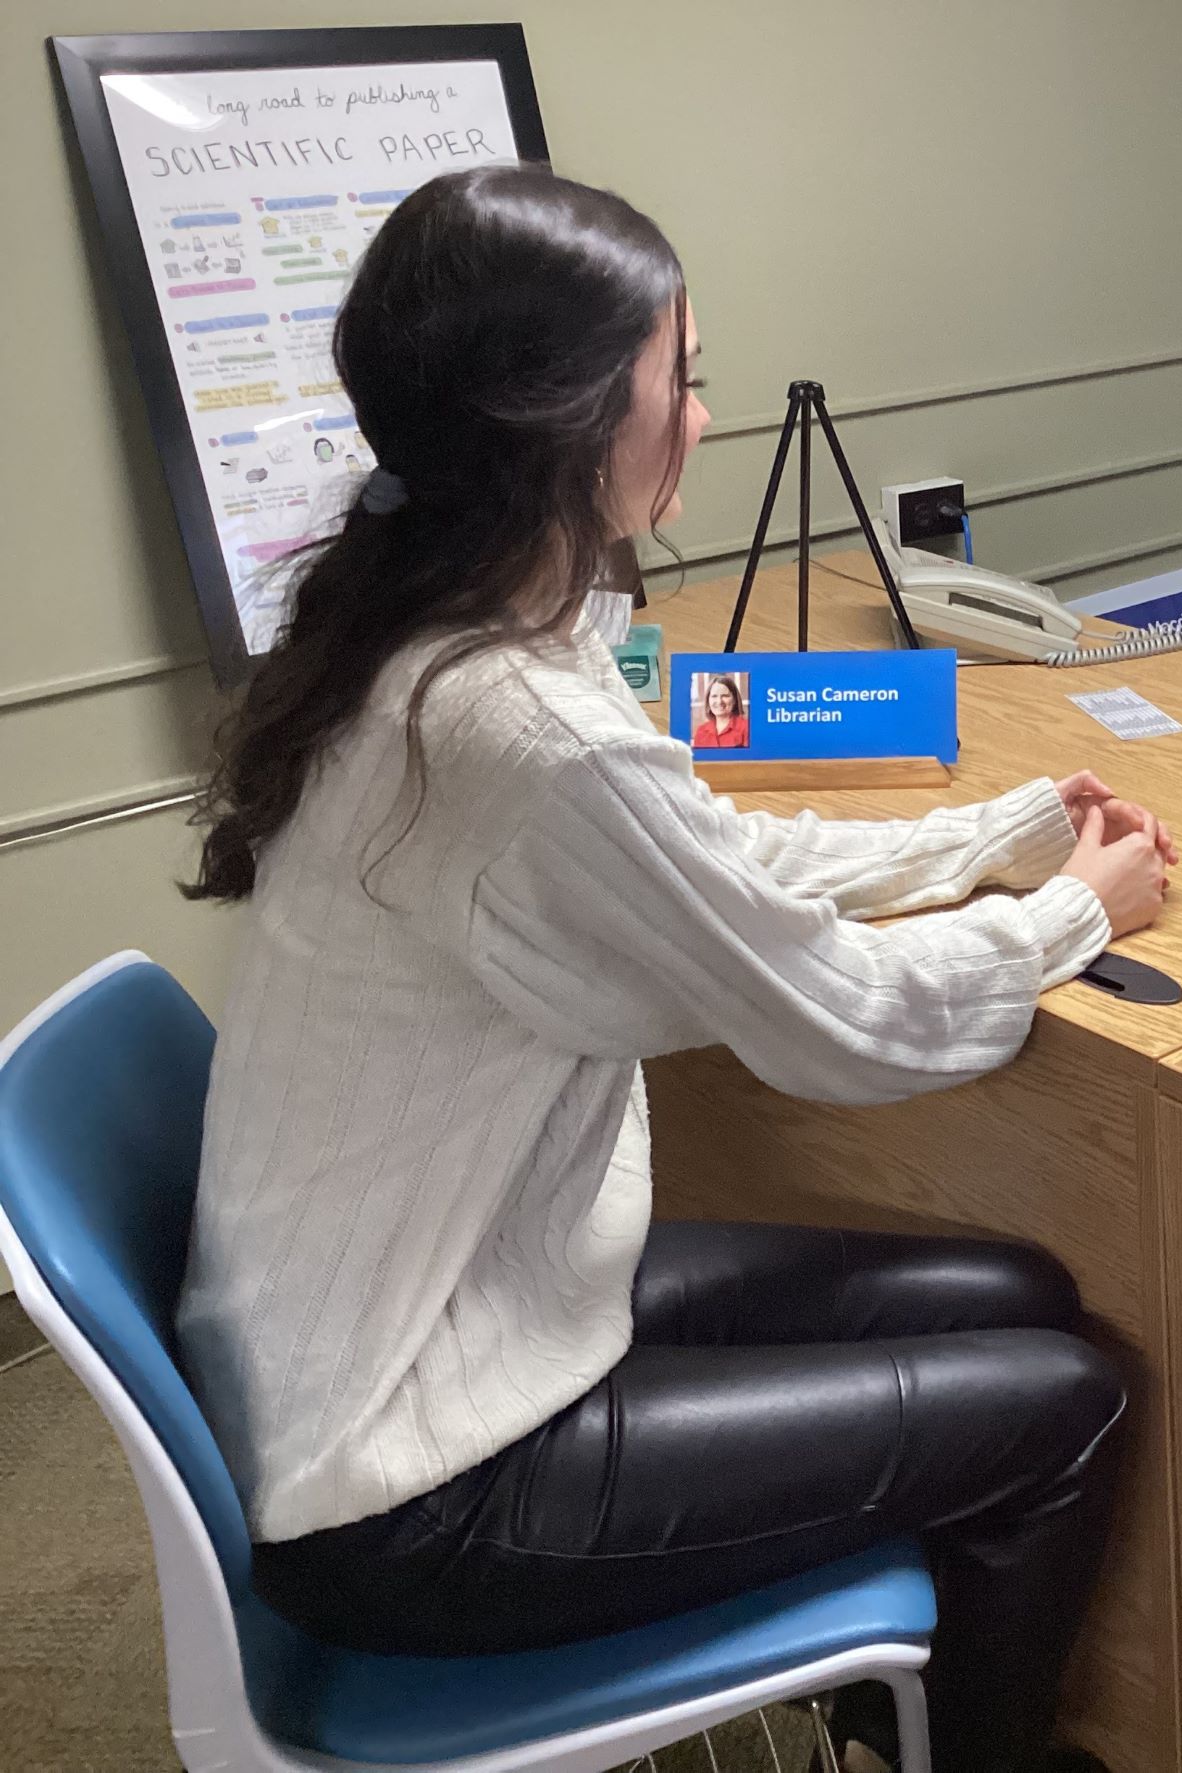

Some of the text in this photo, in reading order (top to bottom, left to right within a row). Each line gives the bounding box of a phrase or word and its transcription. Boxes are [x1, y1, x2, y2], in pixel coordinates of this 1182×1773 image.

[207, 84, 458, 126] long road to publishing a
[145, 128, 496, 178] SCIENTIFIC PAPER
[767, 687, 899, 703] Susan Cameron
[767, 707, 842, 723] Librarian
